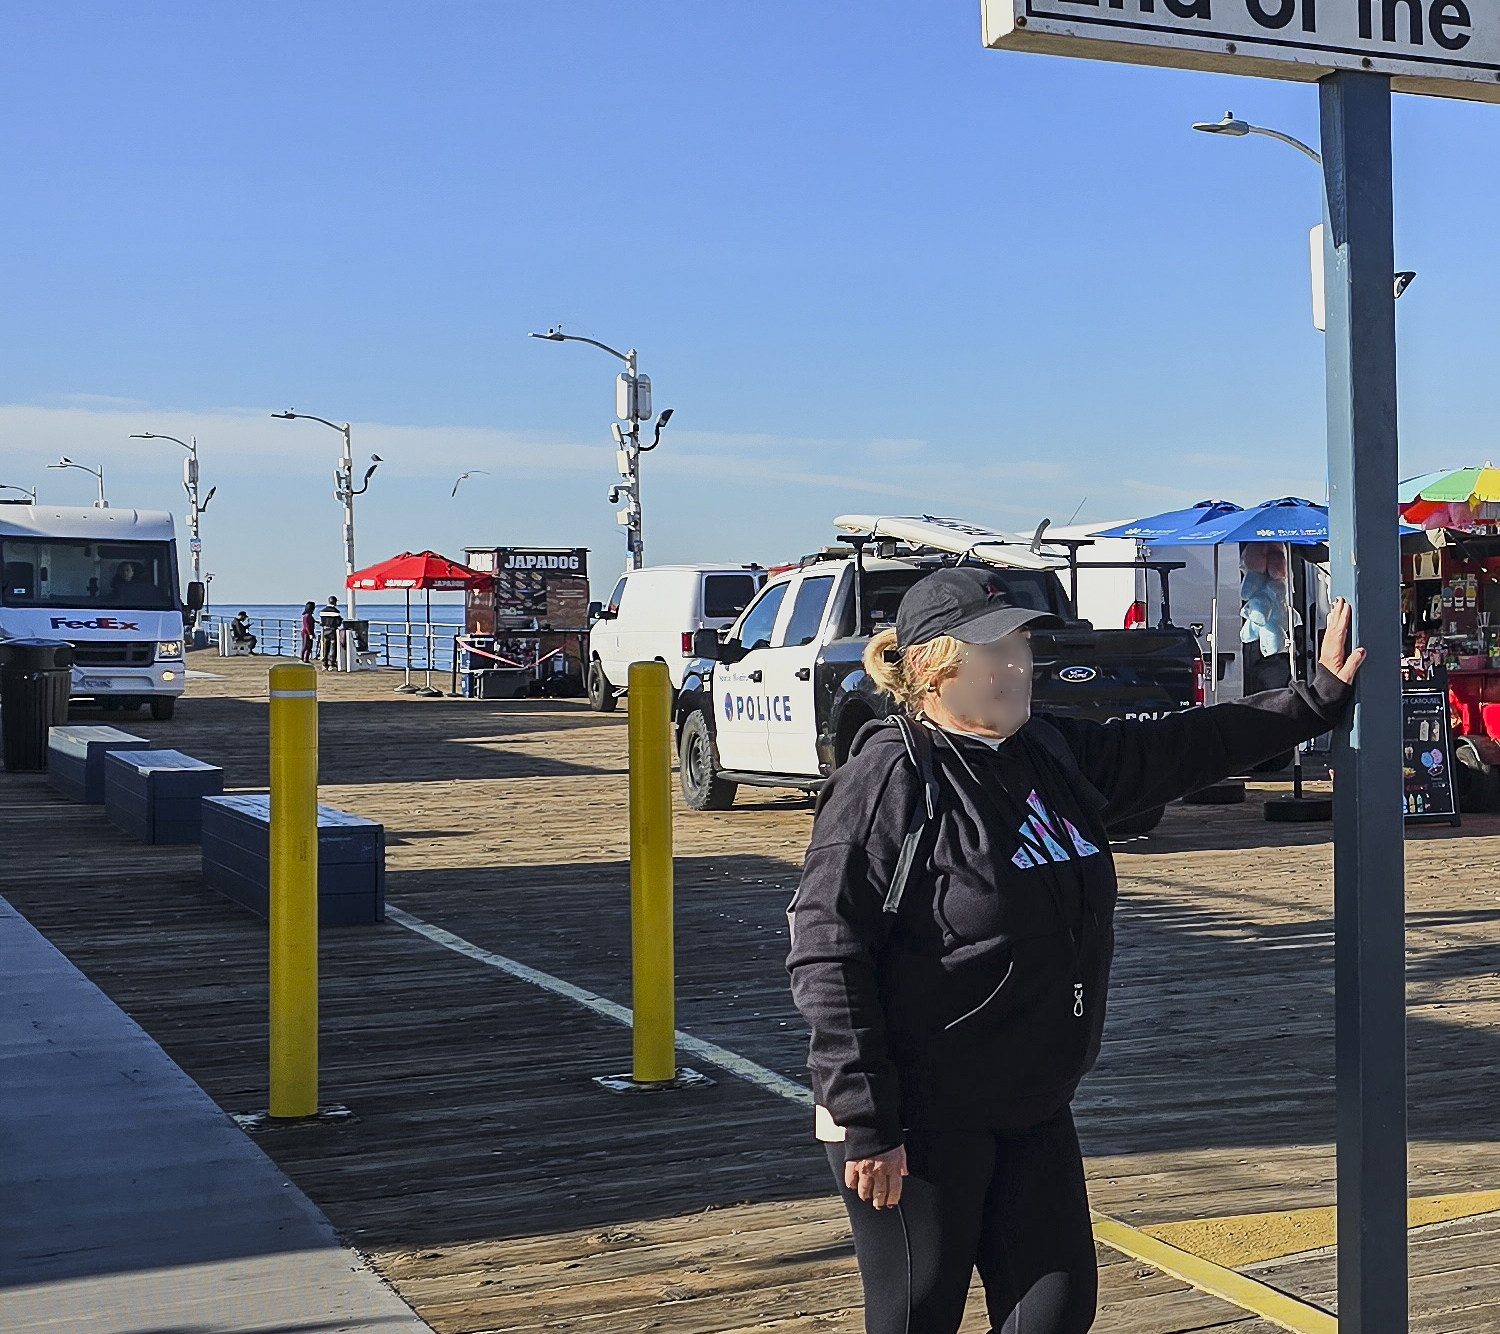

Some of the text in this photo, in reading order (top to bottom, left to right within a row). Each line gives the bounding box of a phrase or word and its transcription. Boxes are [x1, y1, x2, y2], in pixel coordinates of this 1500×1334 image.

[504, 555, 579, 570] JAPADOG
[50, 617, 140, 631] FedEx
[736, 695, 792, 722] POLICE
